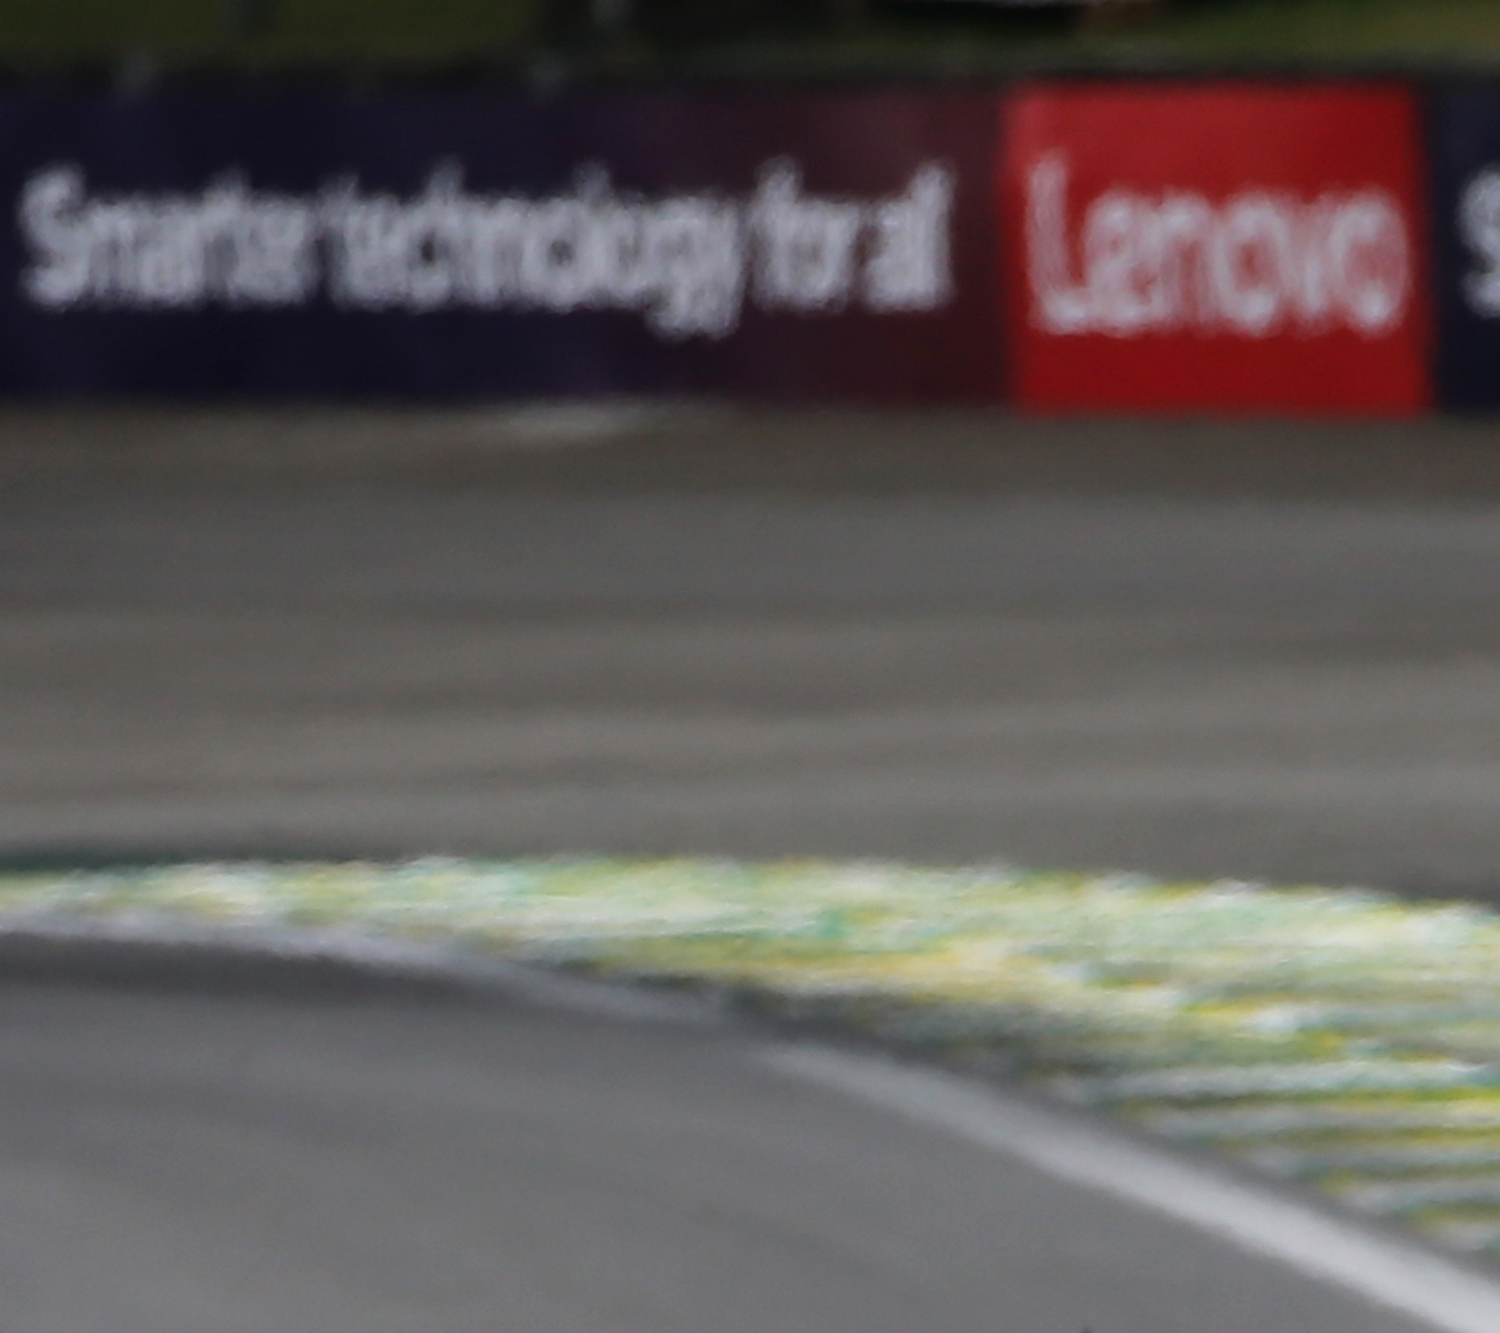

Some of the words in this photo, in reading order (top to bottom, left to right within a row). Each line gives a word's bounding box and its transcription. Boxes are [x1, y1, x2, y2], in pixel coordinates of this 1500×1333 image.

[20, 160, 318, 312] Smarter
[326, 160, 740, 340] technology
[1028, 150, 1410, 335] Lenovo
